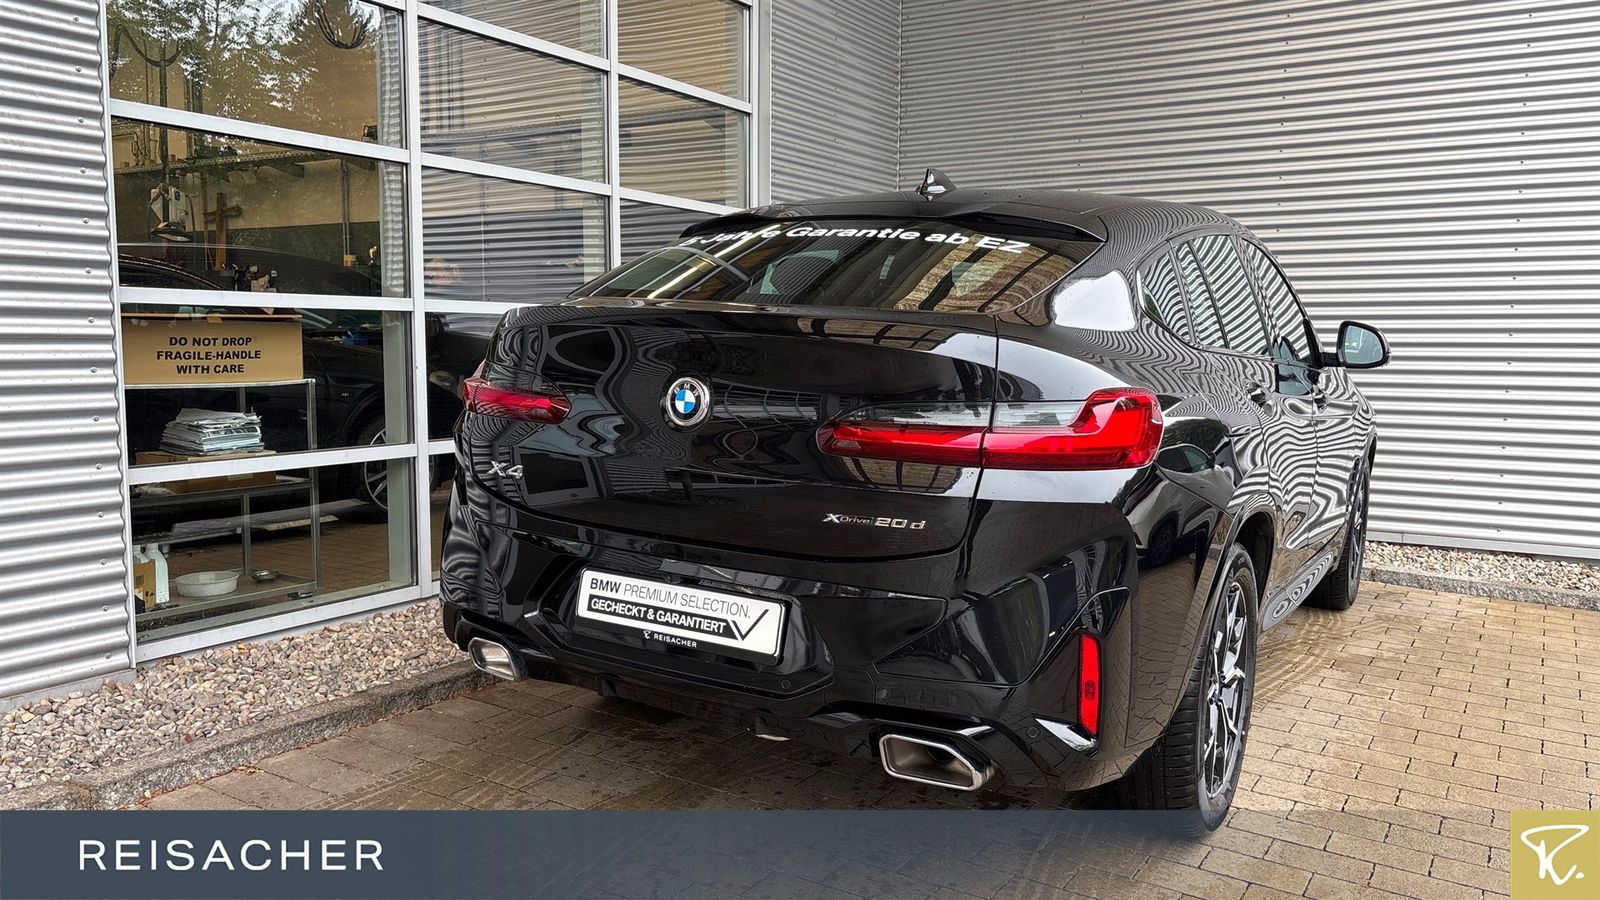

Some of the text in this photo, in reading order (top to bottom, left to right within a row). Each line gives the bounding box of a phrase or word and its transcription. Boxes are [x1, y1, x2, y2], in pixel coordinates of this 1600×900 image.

[700, 230, 781, 244] Jahe
[785, 227, 920, 239] Garantie
[924, 232, 969, 244] ab
[974, 236, 1030, 254] EZ
[169, 337, 252, 347] DO NOT DROP
[156, 350, 261, 361] FRAGILE-HANDLE
[176, 364, 245, 375] WITH CARE
[672, 382, 701, 402] BMW
[487, 461, 524, 479] X4
[589, 577, 621, 594] BMW
[623, 584, 677, 606] PREMIUM
[591, 597, 727, 635] GECHECKT & GARANTIERT
[653, 633, 697, 648] REISACHER
